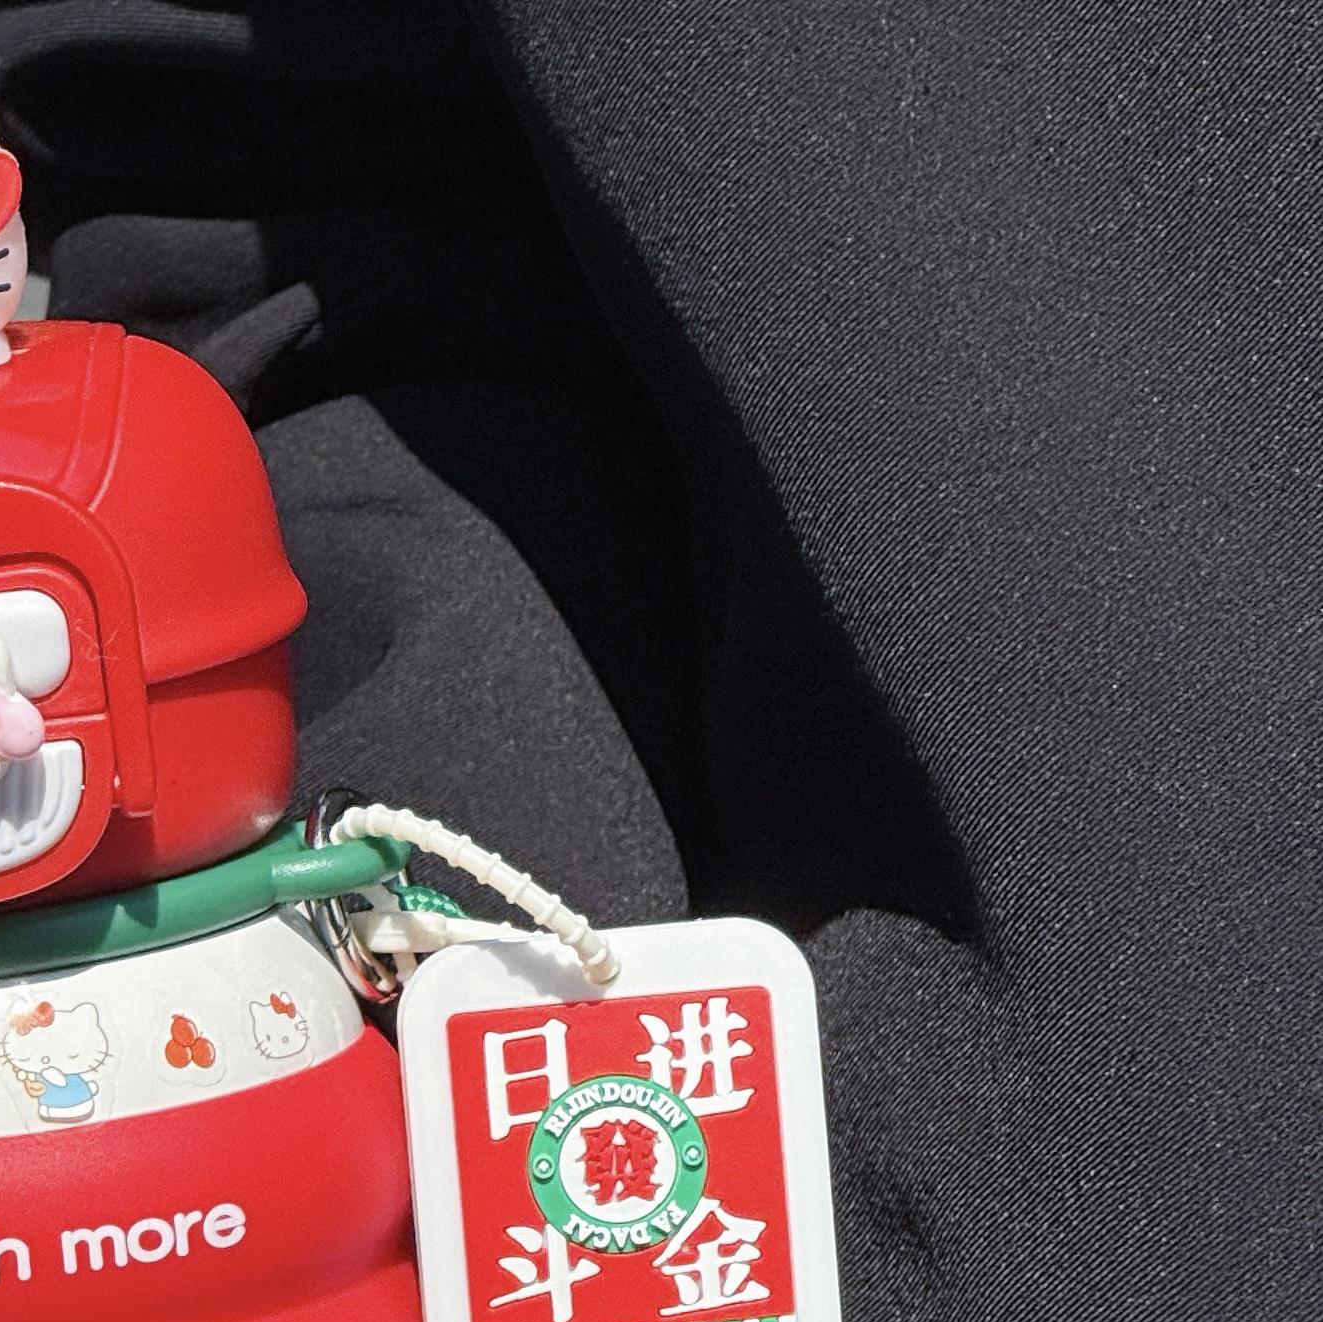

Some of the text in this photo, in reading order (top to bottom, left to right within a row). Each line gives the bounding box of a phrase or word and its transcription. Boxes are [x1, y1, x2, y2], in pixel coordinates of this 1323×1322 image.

[61, 1203, 245, 1274] more
[562, 1201, 687, 1248] FA DACAI
